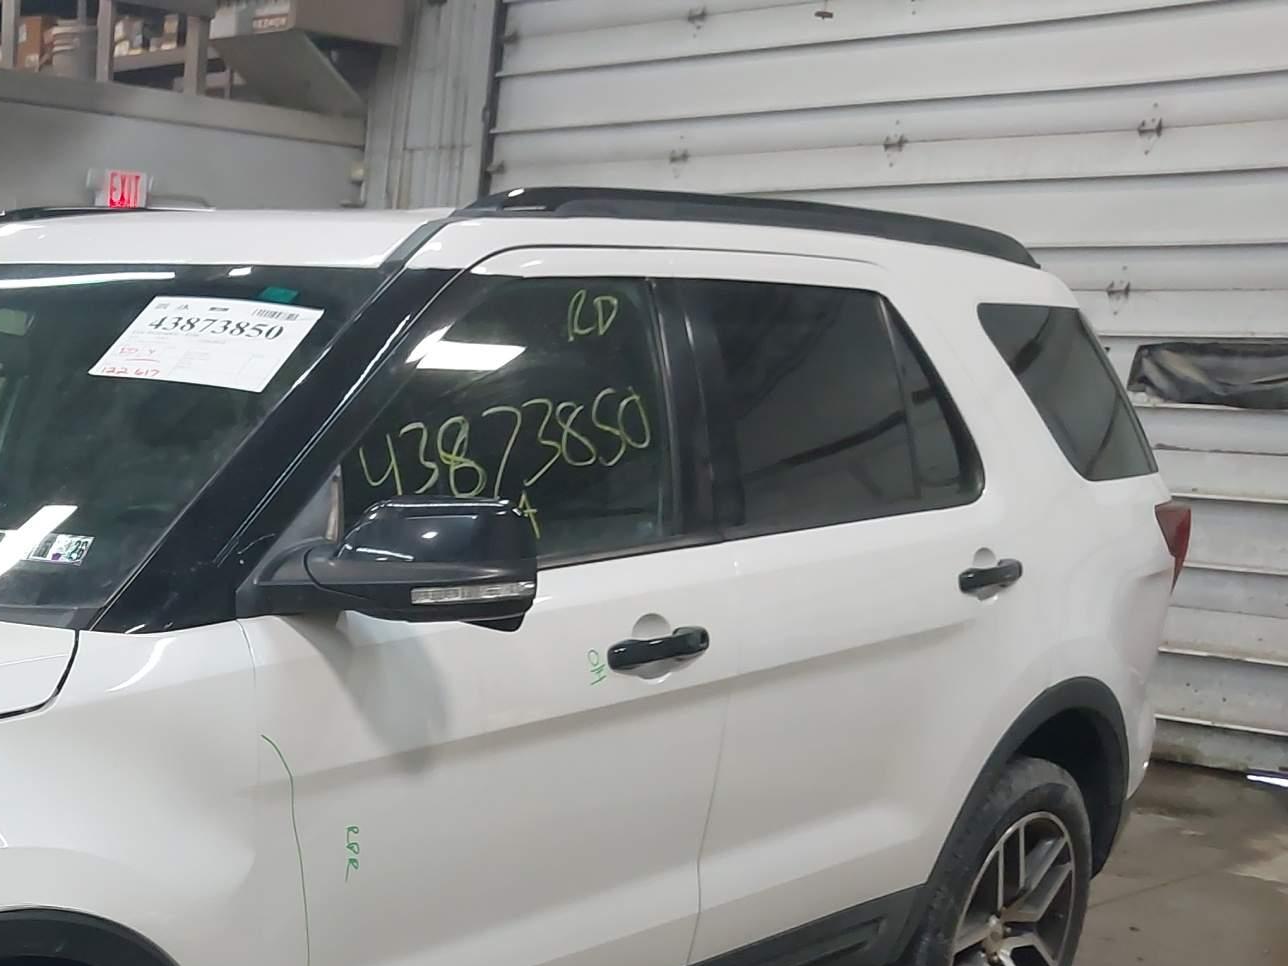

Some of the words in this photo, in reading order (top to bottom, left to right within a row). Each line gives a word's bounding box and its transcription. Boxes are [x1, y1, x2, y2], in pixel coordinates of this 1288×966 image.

[109, 171, 142, 208] EXIT
[148, 316, 285, 341] 43873850
[359, 386, 651, 500] 43873850
